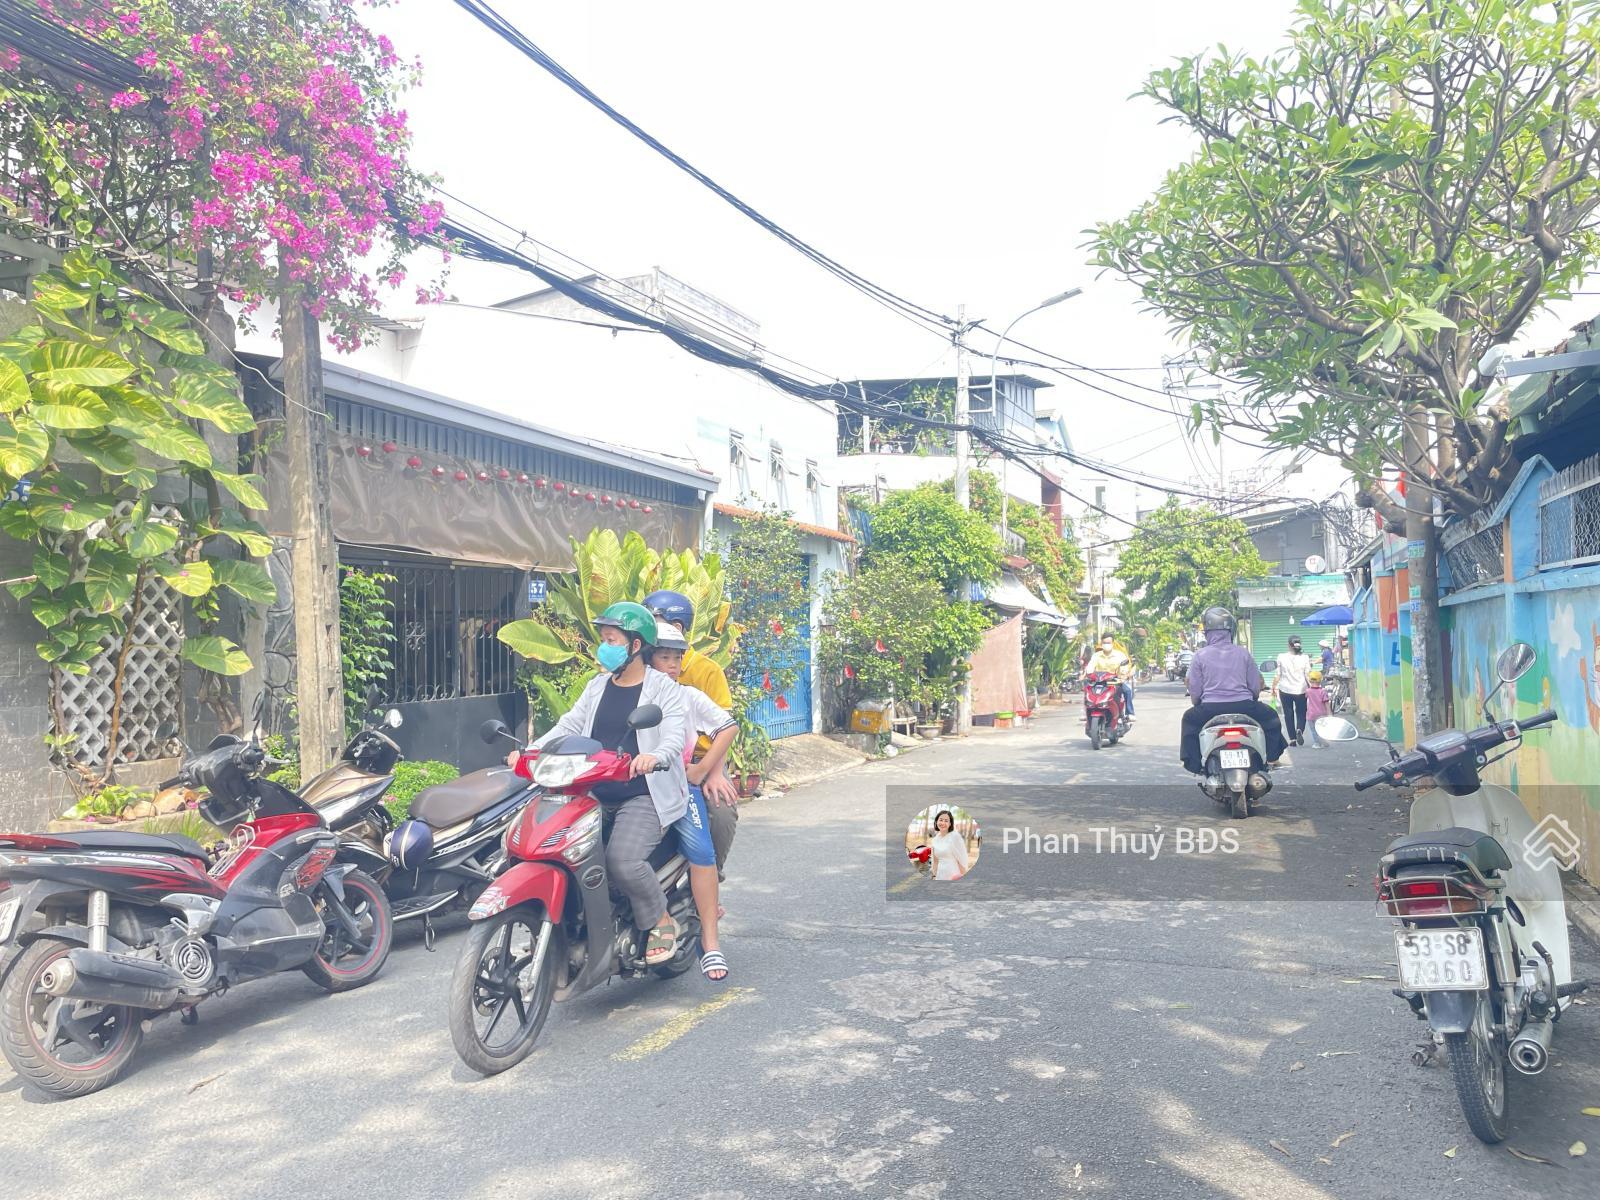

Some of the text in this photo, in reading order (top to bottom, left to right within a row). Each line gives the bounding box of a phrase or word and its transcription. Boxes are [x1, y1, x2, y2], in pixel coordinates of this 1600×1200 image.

[531, 583, 545, 594] 57
[1404, 933, 1468, 956] 53-S8
[1407, 960, 1473, 984] 7360
